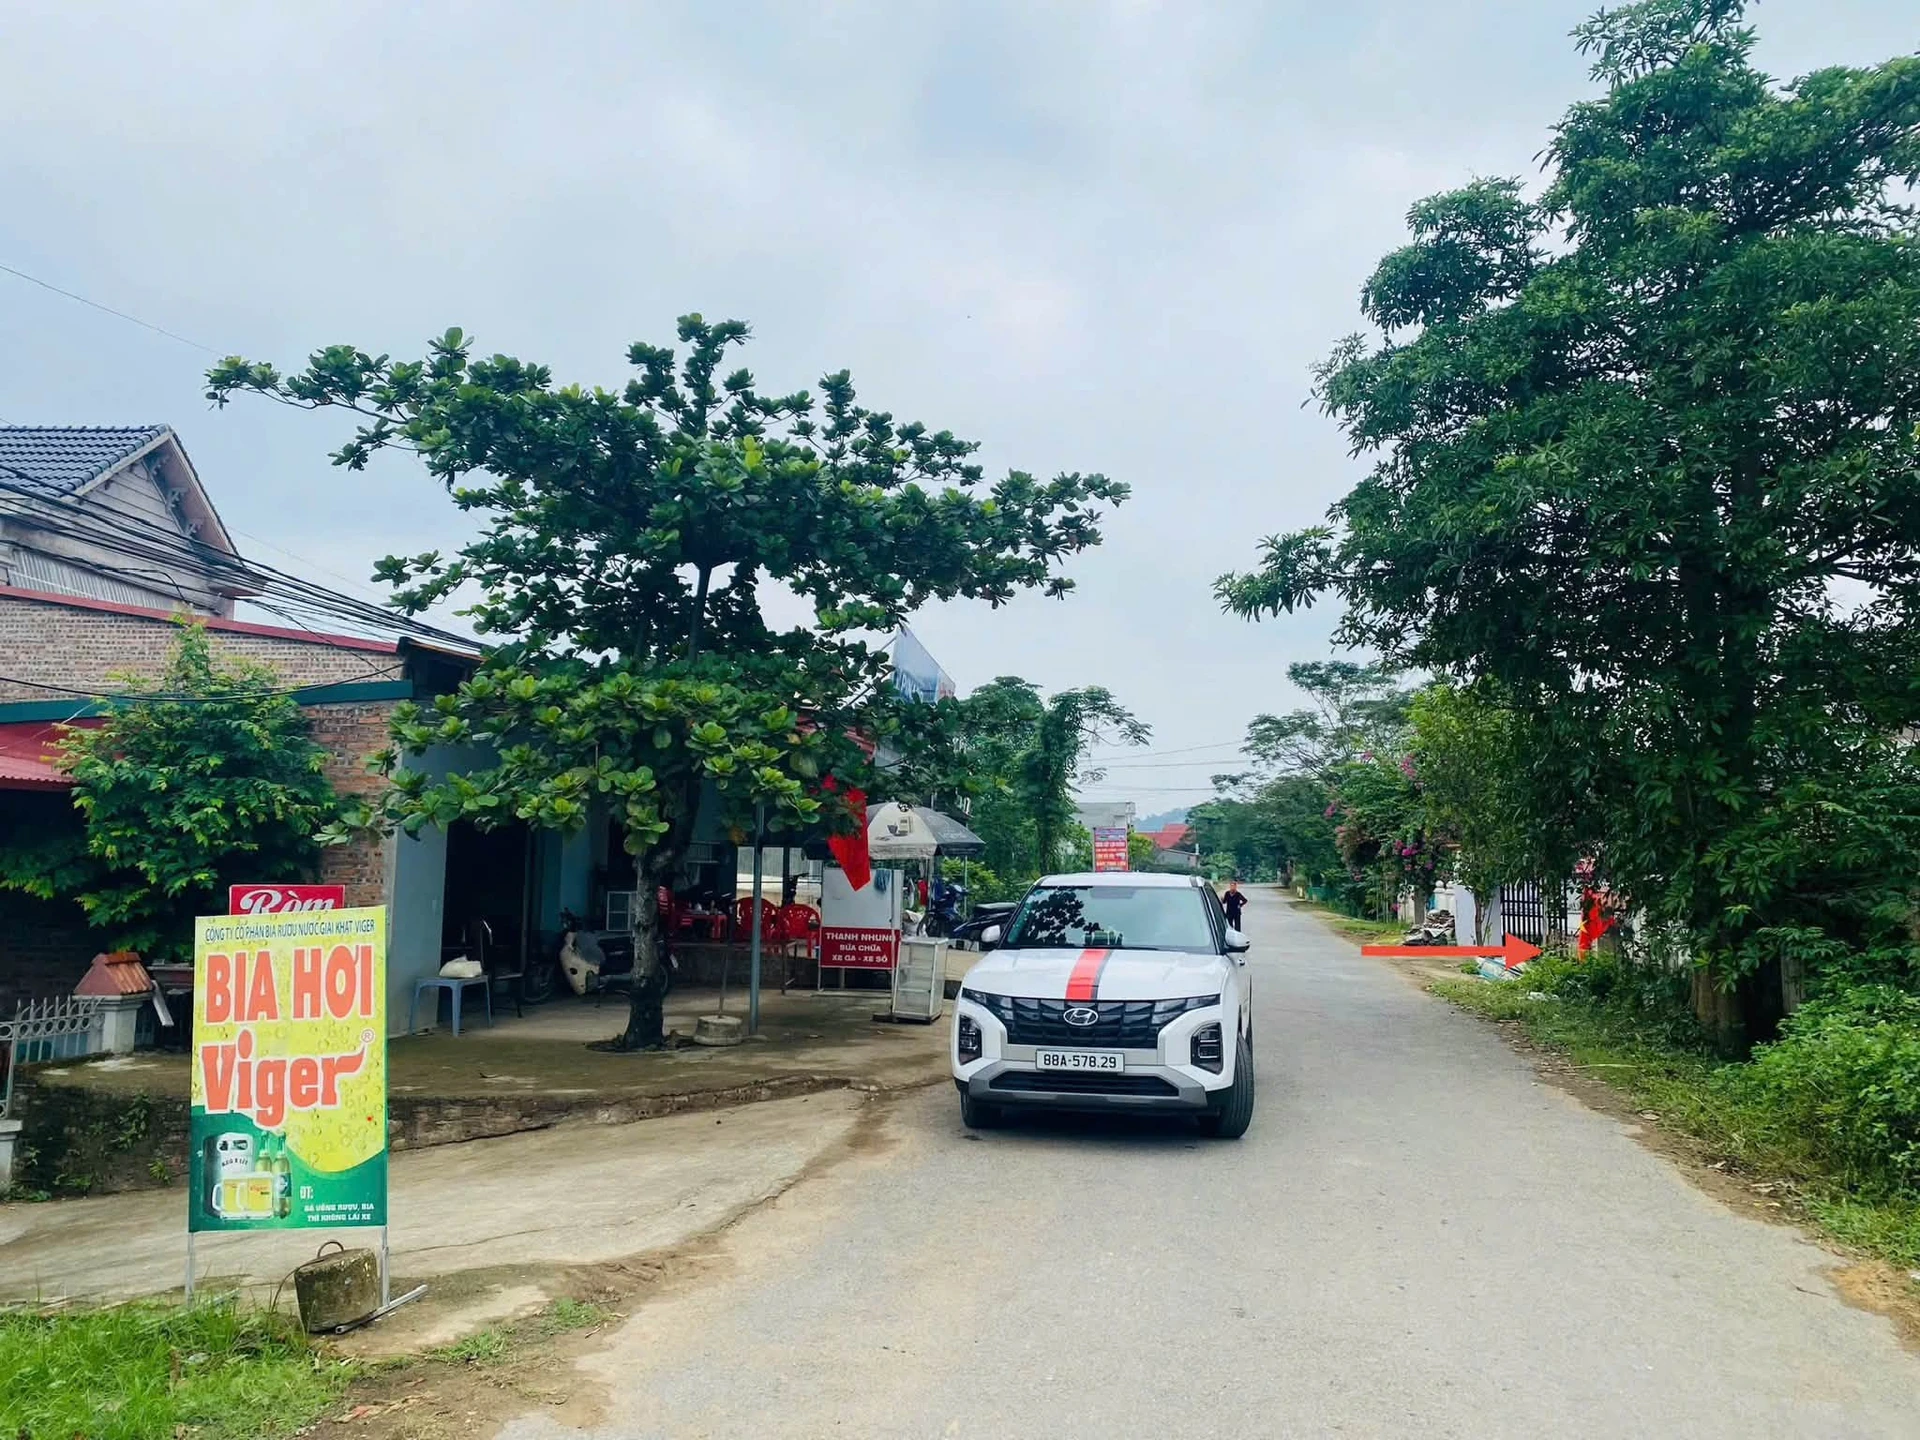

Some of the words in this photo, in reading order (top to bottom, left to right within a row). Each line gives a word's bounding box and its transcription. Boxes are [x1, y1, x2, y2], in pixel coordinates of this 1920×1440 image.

[265, 923, 277, 938] BIA
[354, 918, 375, 933] VIGER
[825, 932, 858, 940] THANH
[206, 950, 279, 1023] BIA
[293, 945, 372, 1019] HƠI
[1044, 1054, 1116, 1068] 88A-578.29
[202, 1029, 365, 1127] Viger
